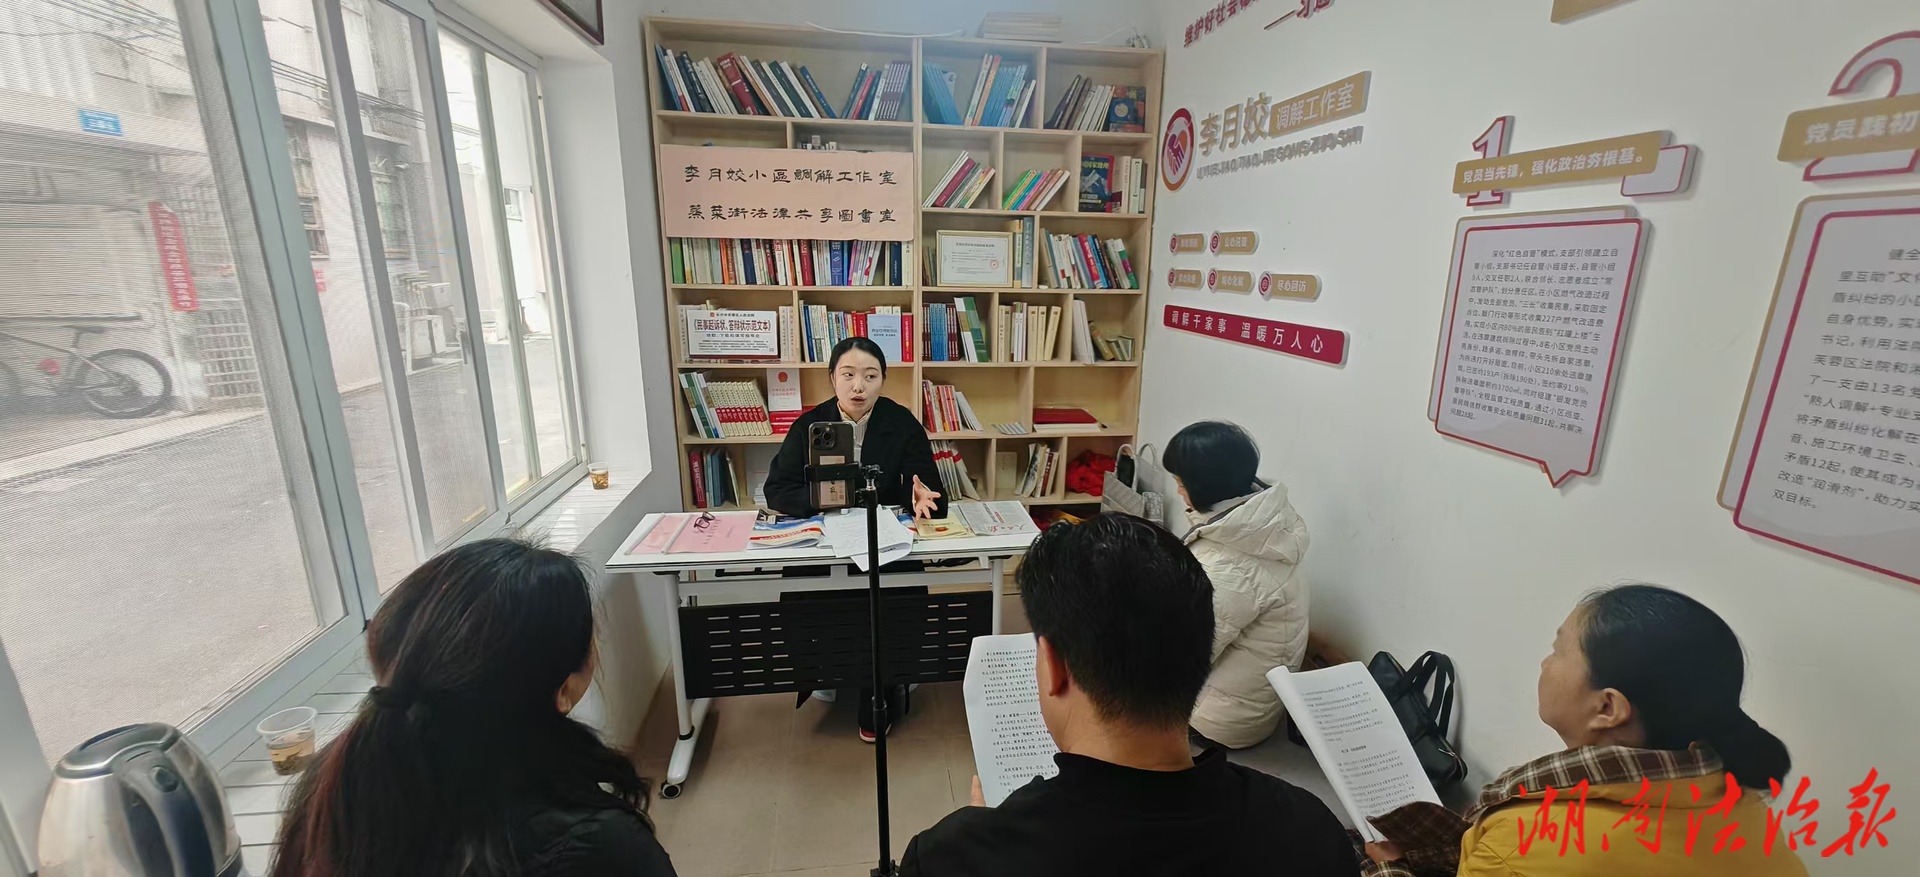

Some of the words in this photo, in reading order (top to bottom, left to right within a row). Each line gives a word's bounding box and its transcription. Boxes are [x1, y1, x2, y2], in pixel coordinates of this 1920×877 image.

[1199, 92, 1272, 157] 李月姣
[1276, 83, 1354, 130] 调解工作室
[1171, 310, 1226, 334] 调解千家事
[1241, 321, 1323, 354] 温暖万人心
[1790, 432, 1920, 468] 音、施工环境卫生、
